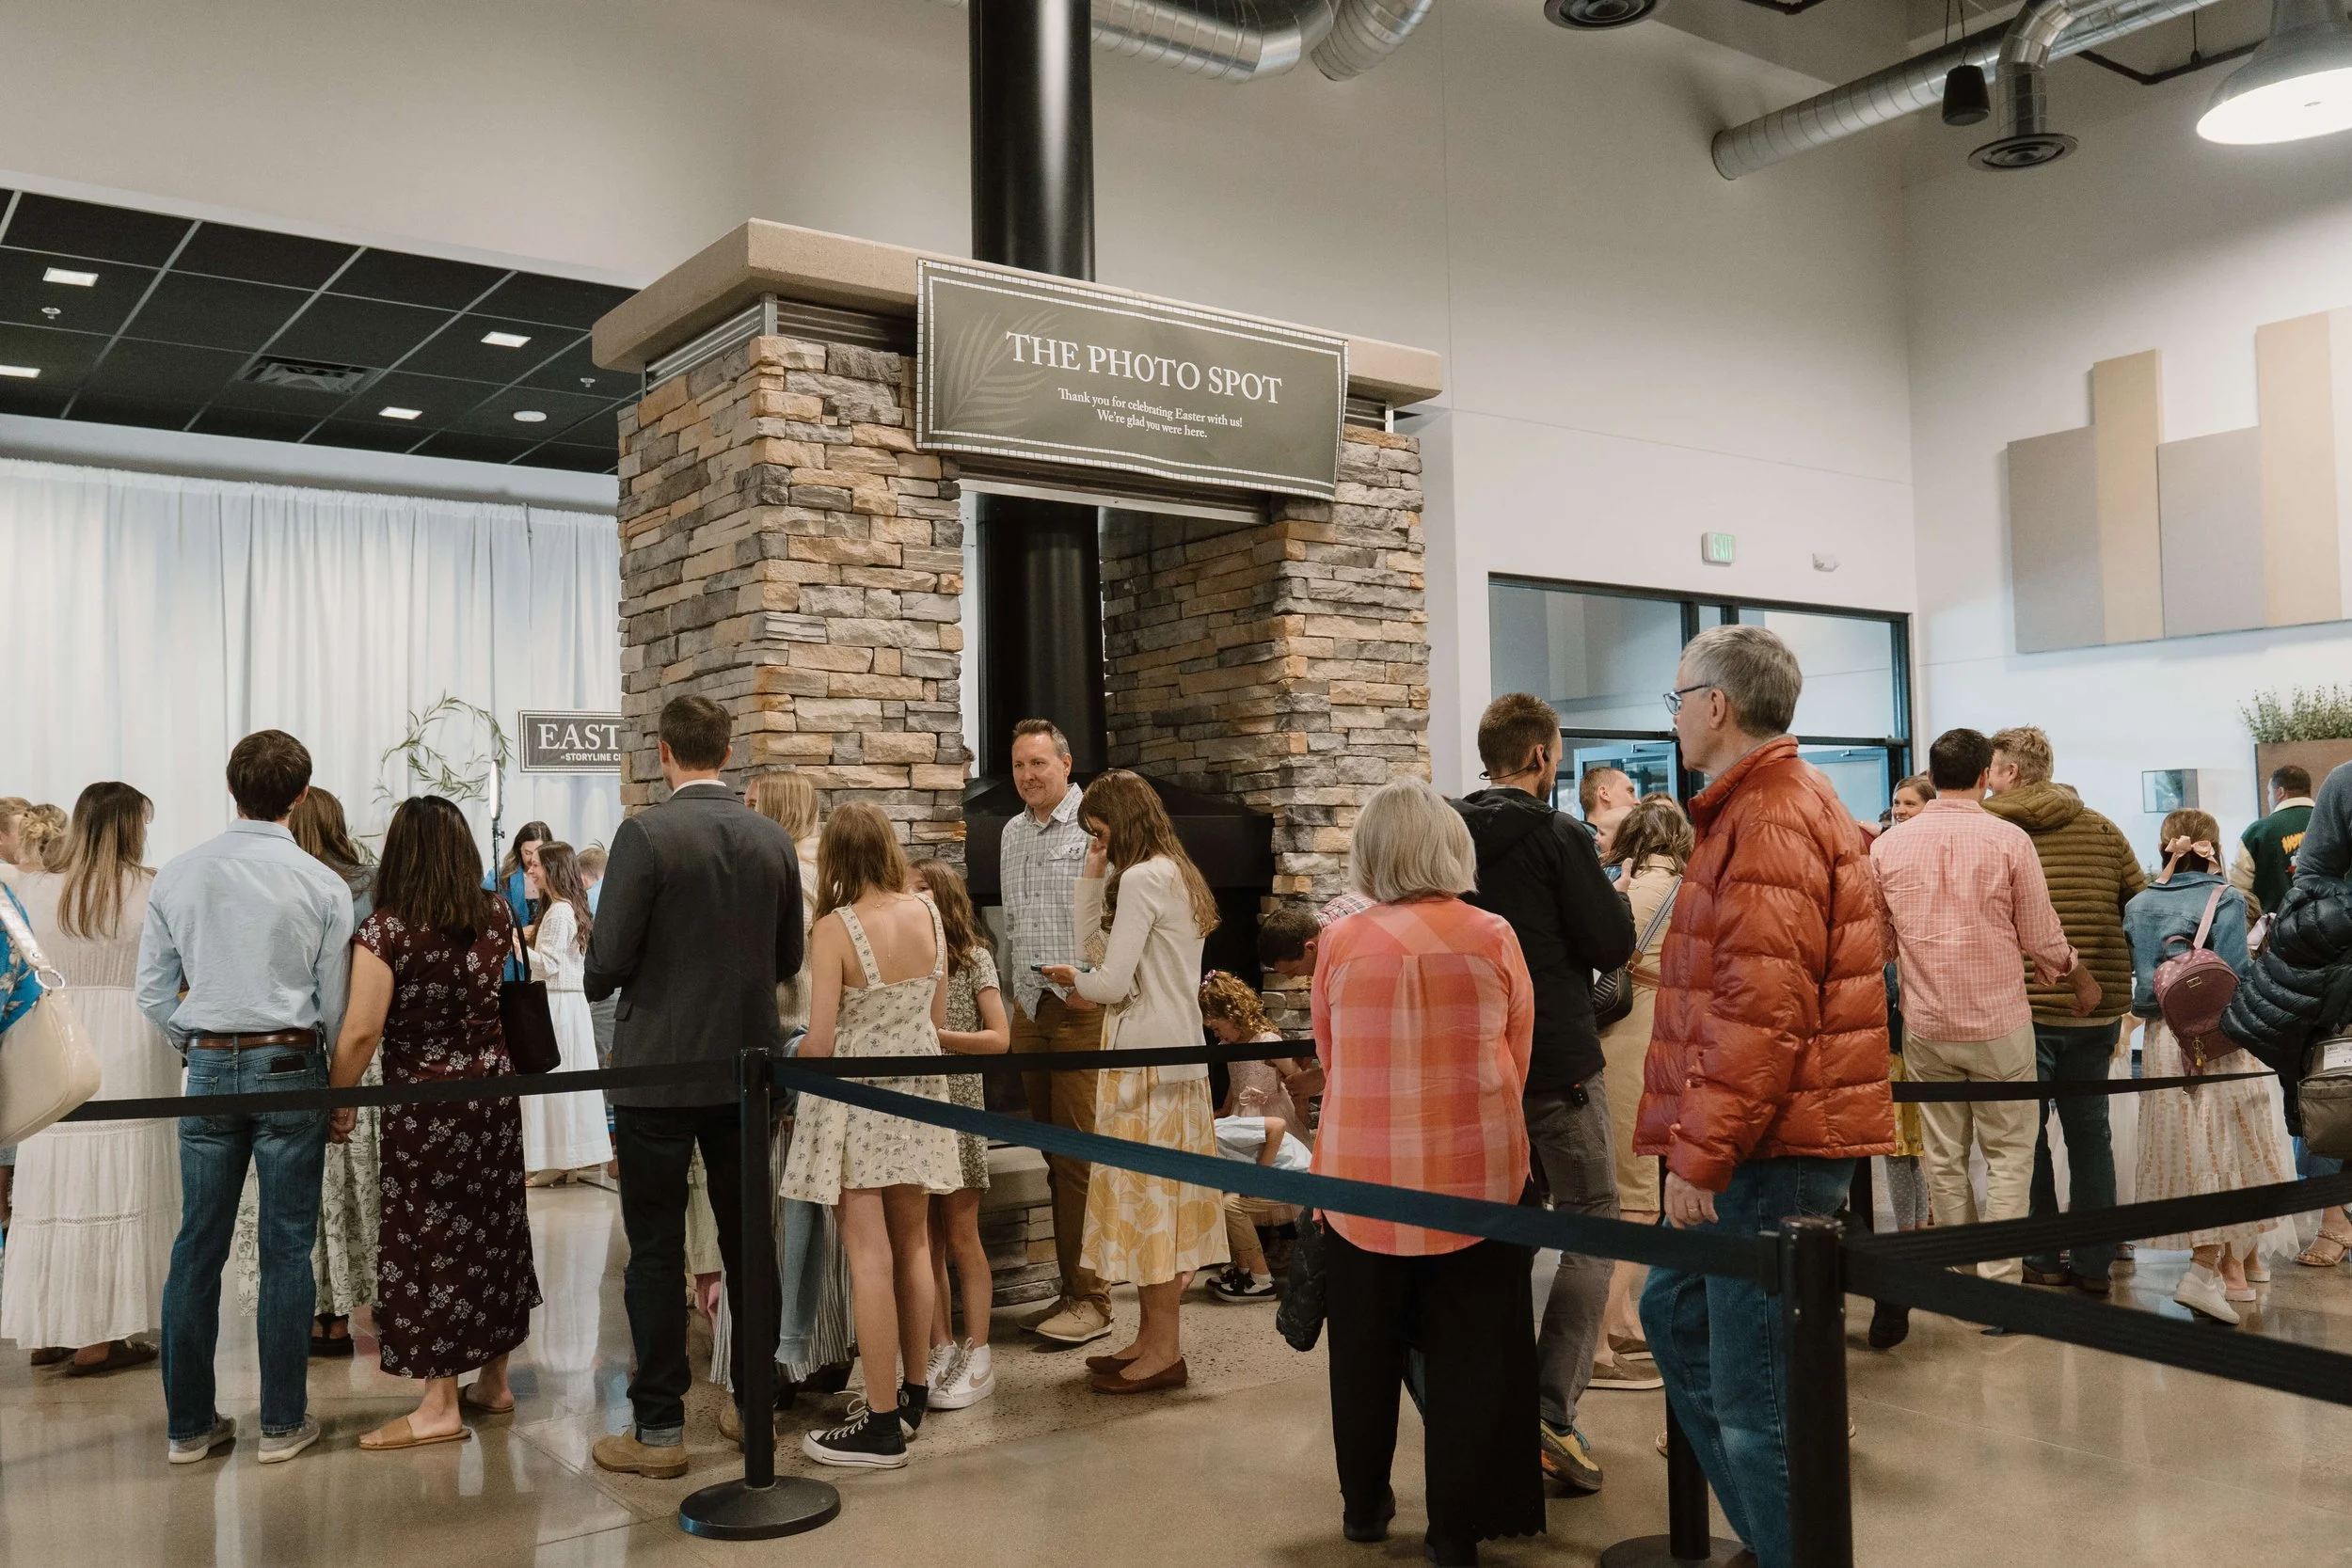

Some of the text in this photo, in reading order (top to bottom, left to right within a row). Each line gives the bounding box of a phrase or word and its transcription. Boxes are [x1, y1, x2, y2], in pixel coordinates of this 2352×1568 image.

[1006, 331, 1282, 404] THE PHOTO SPOT
[1057, 388, 1243, 428] Thank you for celebrating Easter with us!
[1096, 409, 1208, 438] We’re glad you were here.
[1712, 533, 1733, 562] EXIT
[537, 723, 620, 751] EAST
